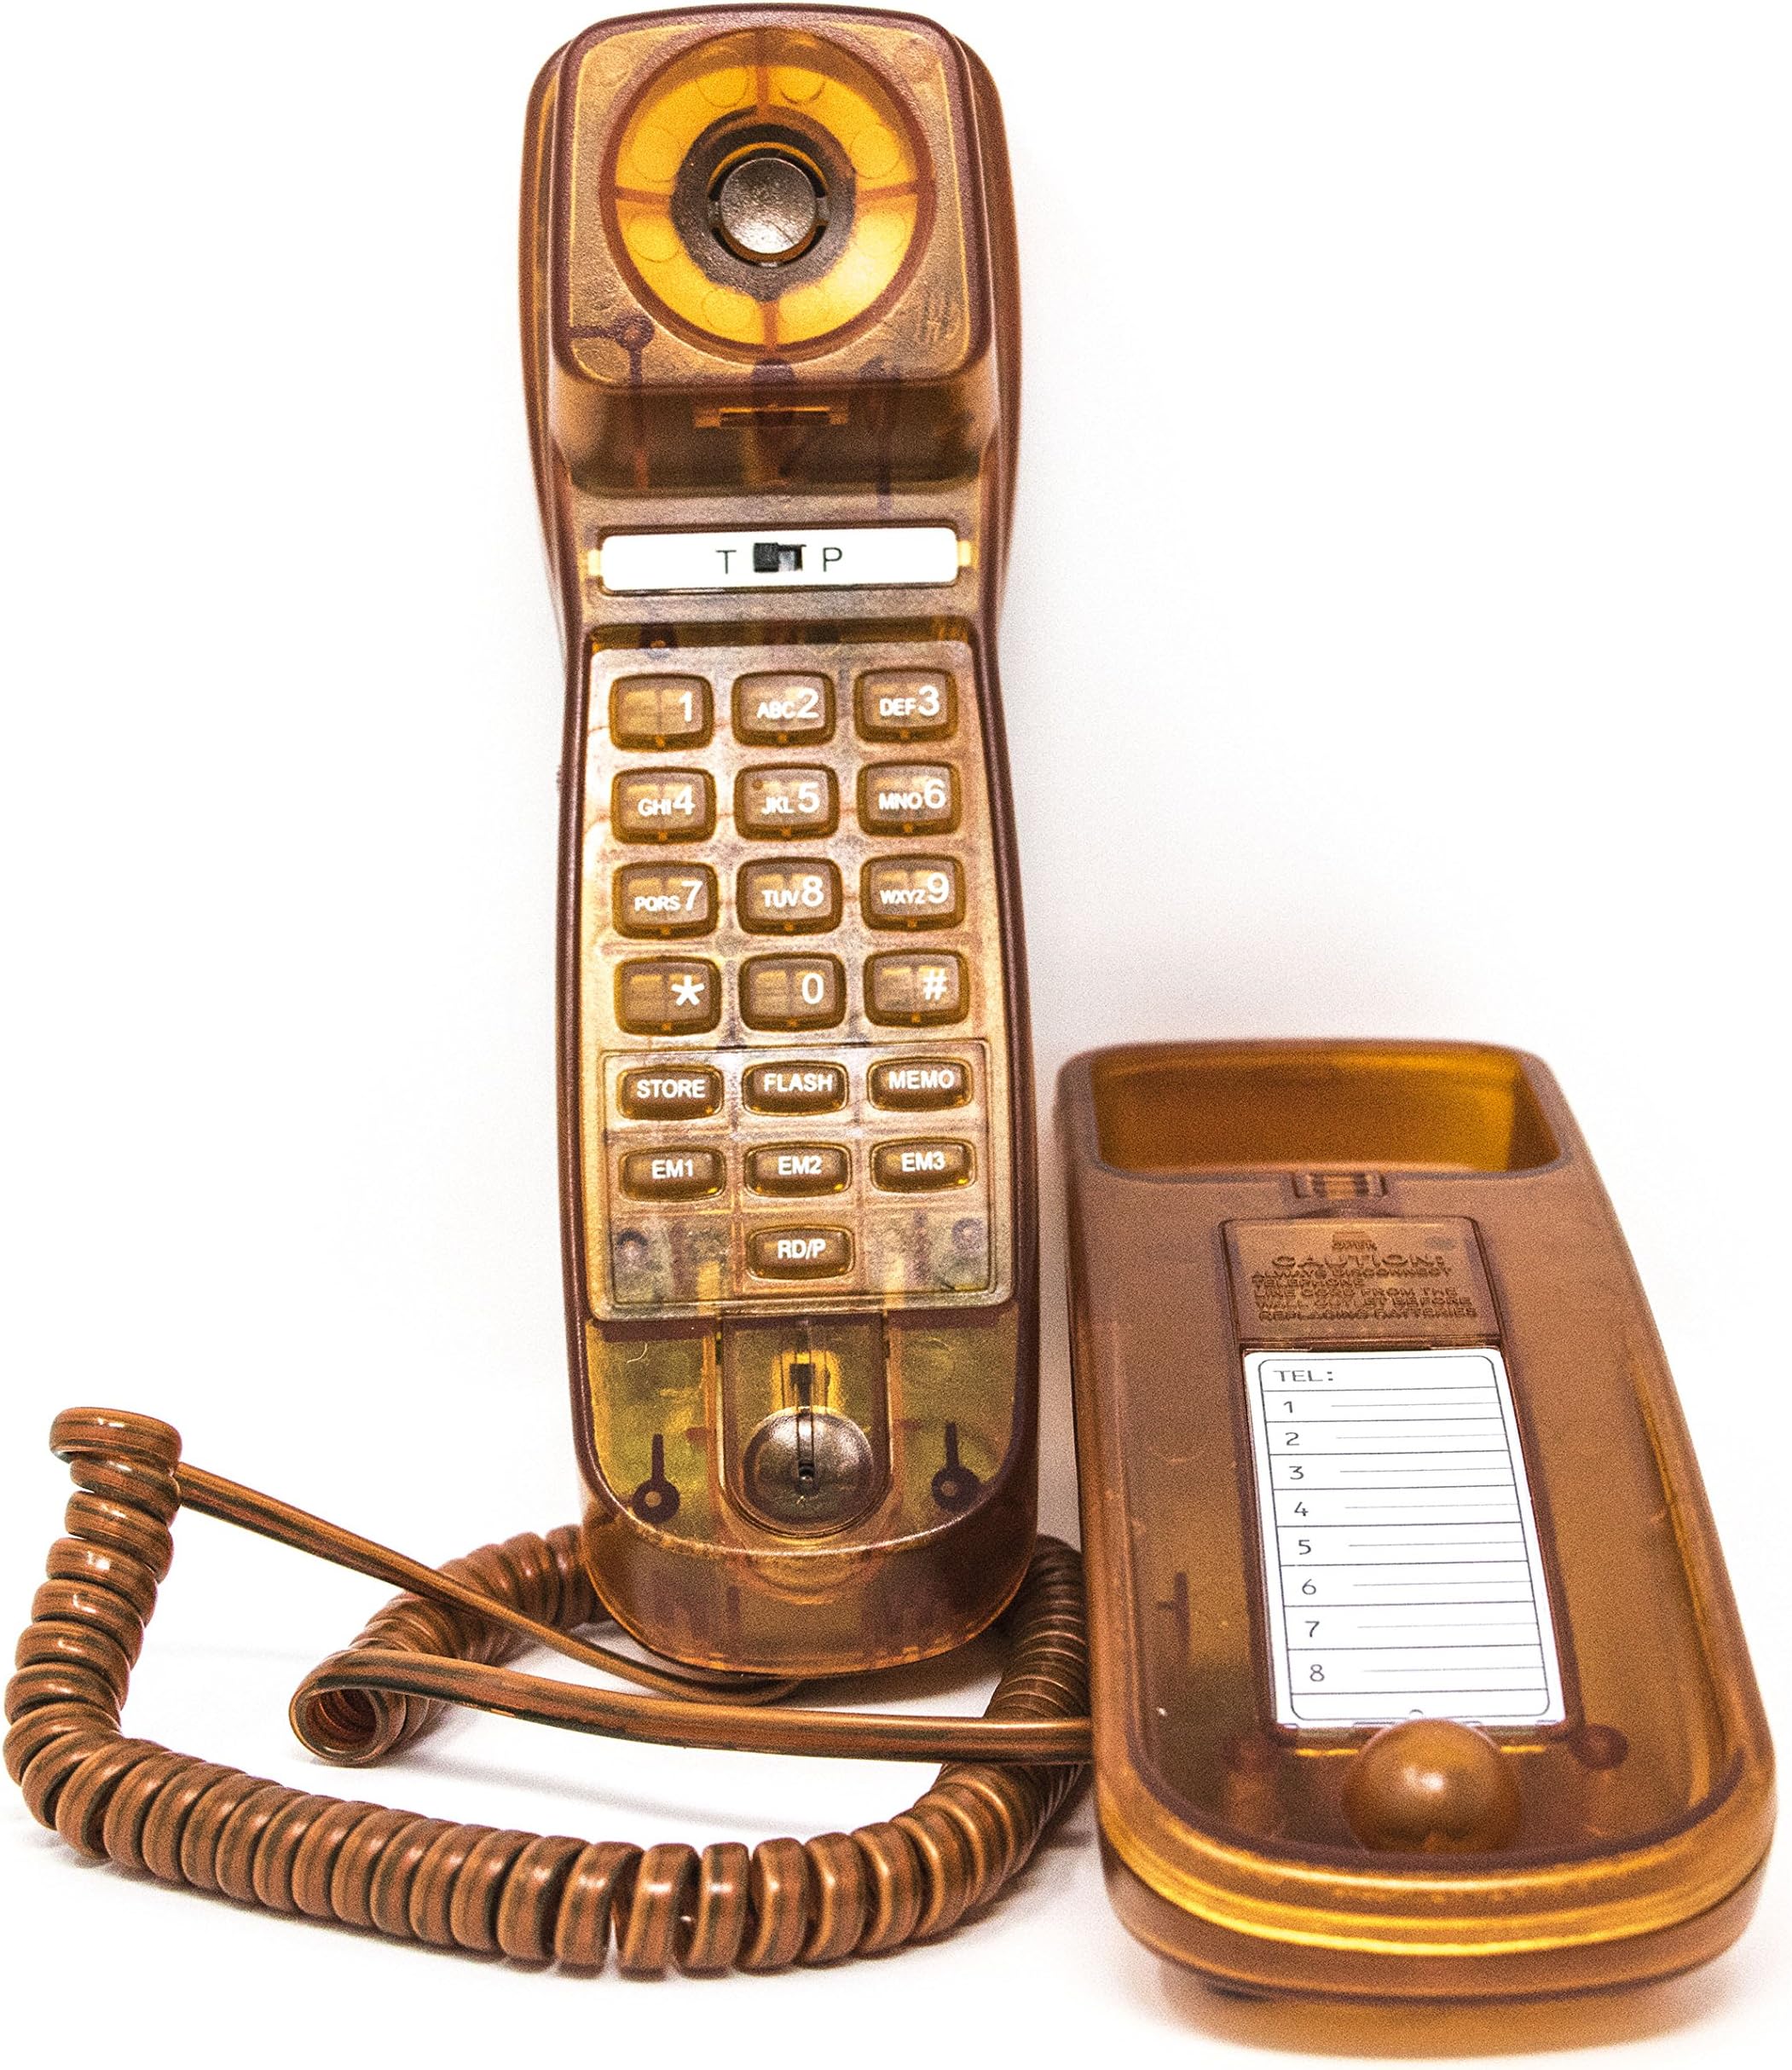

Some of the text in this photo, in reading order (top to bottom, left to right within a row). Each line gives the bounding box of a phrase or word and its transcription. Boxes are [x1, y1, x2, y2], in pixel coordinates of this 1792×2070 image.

[715, 549, 737, 575] T
[823, 546, 843, 572] P
[679, 691, 692, 722] 1
[801, 972, 824, 1005] 0
[636, 1078, 706, 1100] STORE
[763, 1072, 833, 1093] FLASH
[888, 1068, 955, 1090] MEMO
[650, 1159, 695, 1180] EM1
[777, 1154, 823, 1176] EM2
[900, 1151, 945, 1172] EM3
[777, 1238, 826, 1260] RD/P
[1274, 1369, 1334, 1383] TEL:
[1284, 1400, 1294, 1414] 1
[1286, 1431, 1300, 1447] 2
[1289, 1465, 1304, 1481] 3
[1294, 1501, 1309, 1518] 4
[1298, 1539, 1312, 1555] 5
[1301, 1579, 1317, 1596] 6
[1304, 1620, 1321, 1638] 7
[1309, 1663, 1325, 1683] 8
